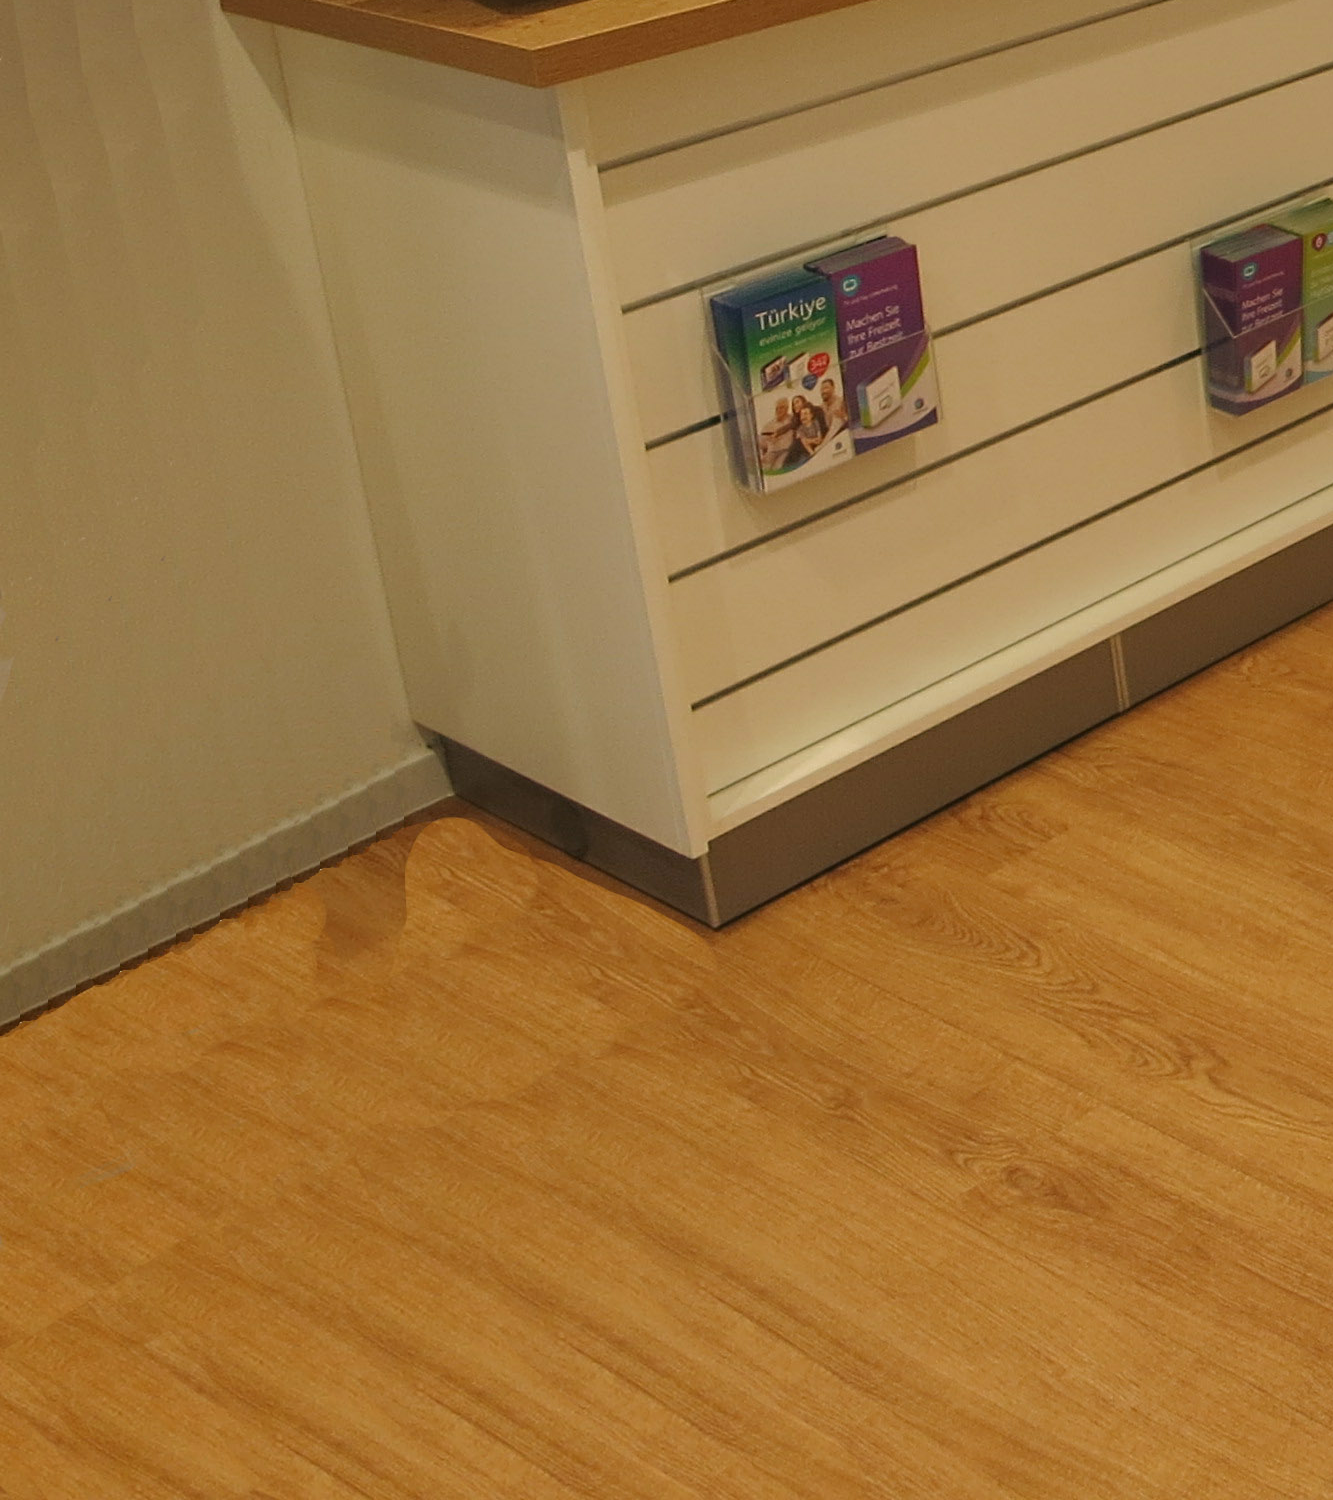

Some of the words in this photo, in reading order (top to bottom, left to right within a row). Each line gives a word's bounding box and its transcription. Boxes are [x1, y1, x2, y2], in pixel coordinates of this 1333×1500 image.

[755, 296, 827, 331] Türkiye
[846, 311, 884, 332] Machen
[885, 304, 900, 318] Sie
